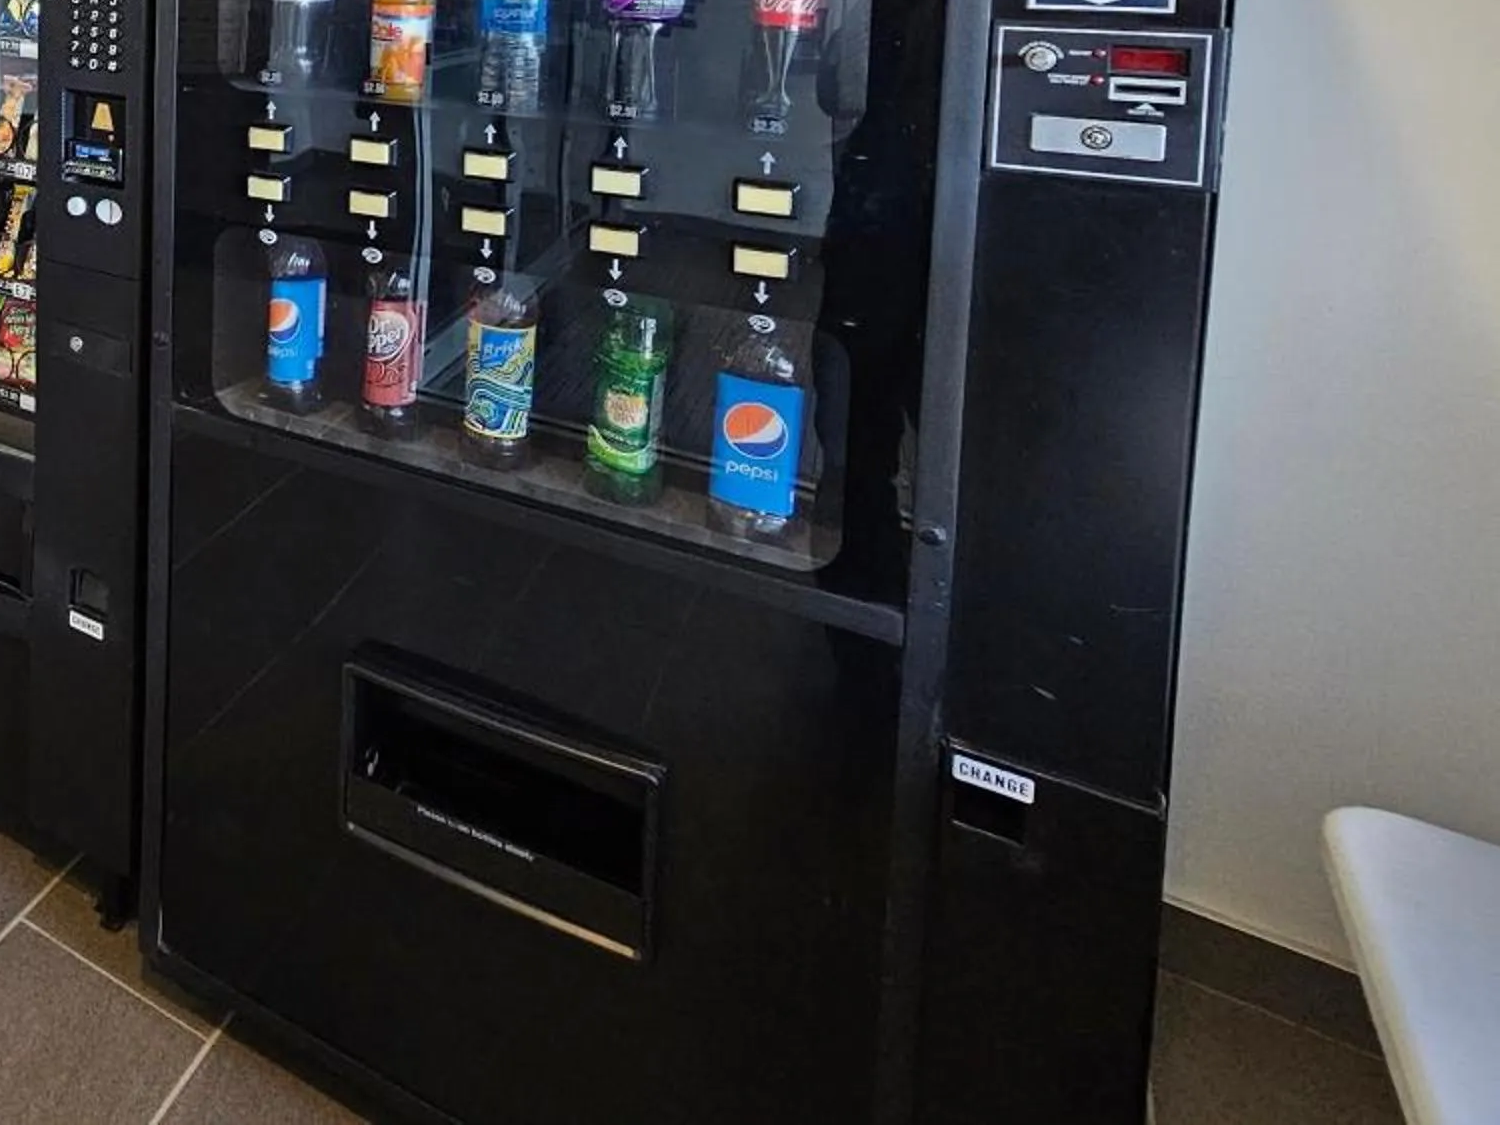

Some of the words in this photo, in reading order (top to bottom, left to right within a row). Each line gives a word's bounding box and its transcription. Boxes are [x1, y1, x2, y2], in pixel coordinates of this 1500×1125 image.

[71, 25, 79, 35] 4
[71, 40, 79, 51] 7
[369, 315, 391, 335] Dr
[483, 338, 523, 357] Brisk
[725, 460, 779, 483] pepsi
[958, 762, 1030, 798] CHANGE
